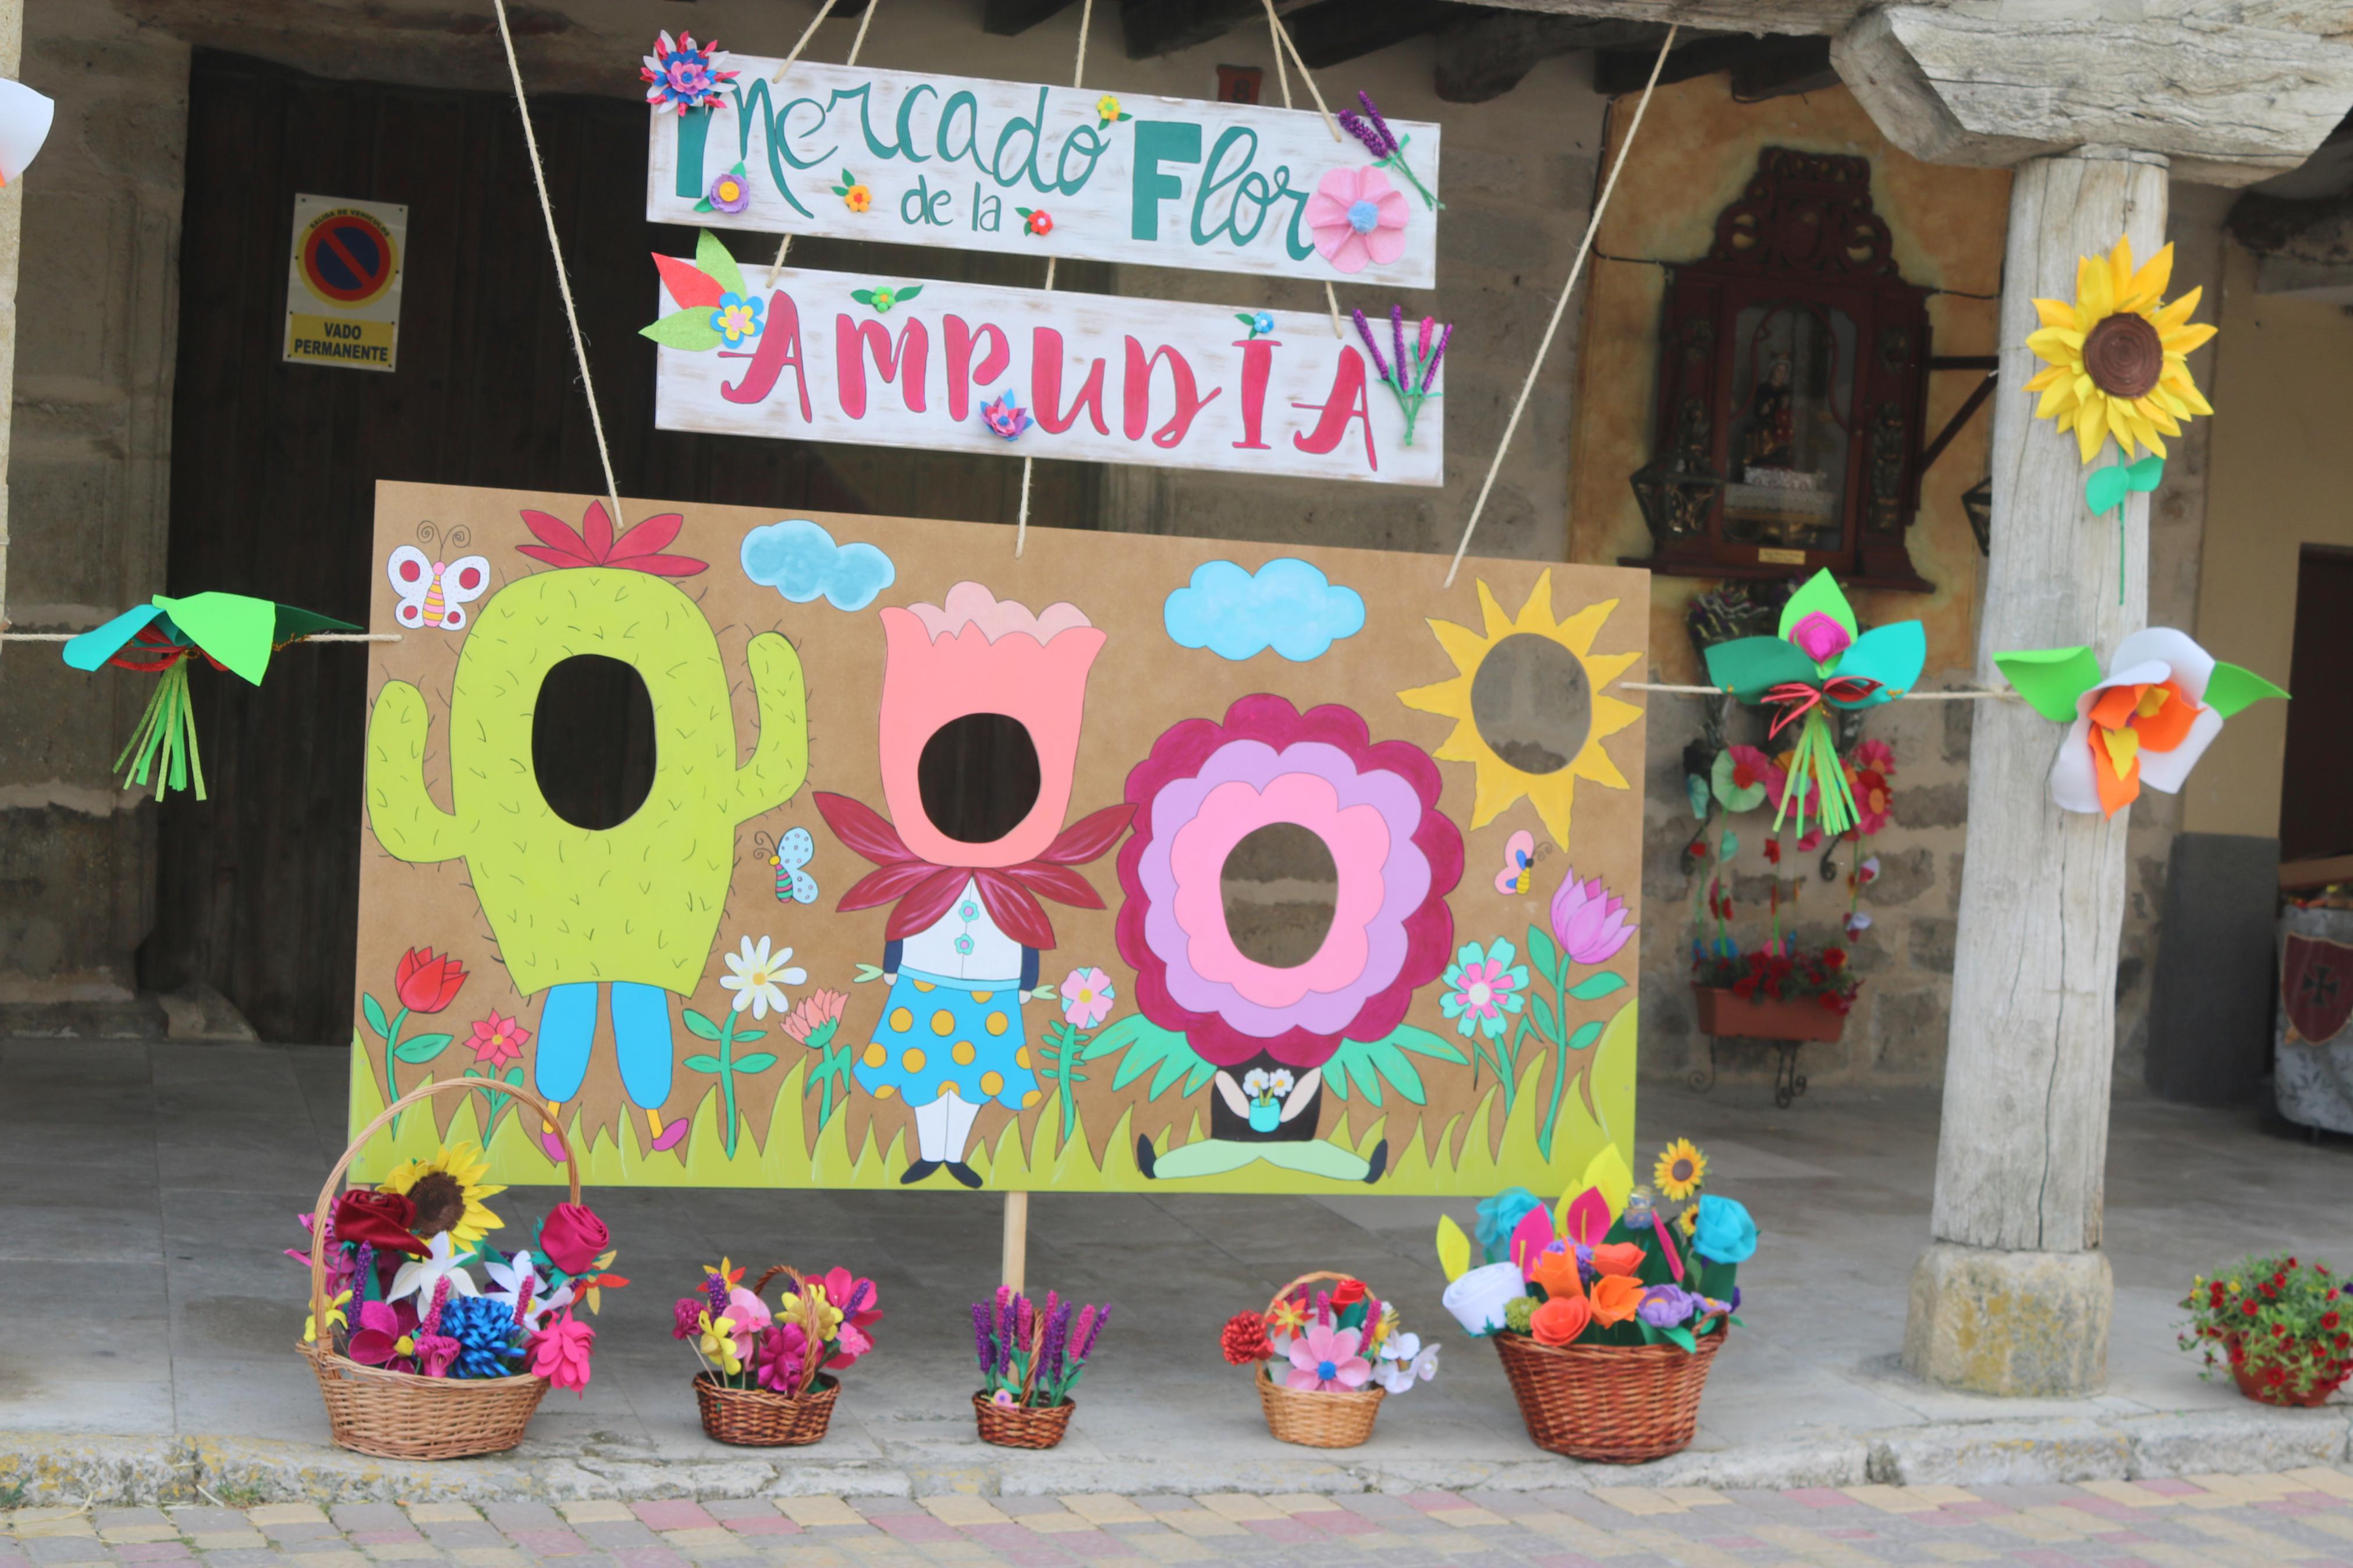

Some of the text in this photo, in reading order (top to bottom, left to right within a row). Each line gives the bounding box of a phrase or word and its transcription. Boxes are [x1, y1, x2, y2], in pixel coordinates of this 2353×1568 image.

[676, 77, 1314, 261] Mercado Flor
[310, 211, 336, 229] SALIDA
[350, 209, 390, 237] VEHICULOS
[901, 175, 1001, 232] de la
[294, 339, 388, 362] PERMANENTE
[324, 322, 362, 340] VADO
[718, 289, 1378, 472] AMPUDIA
